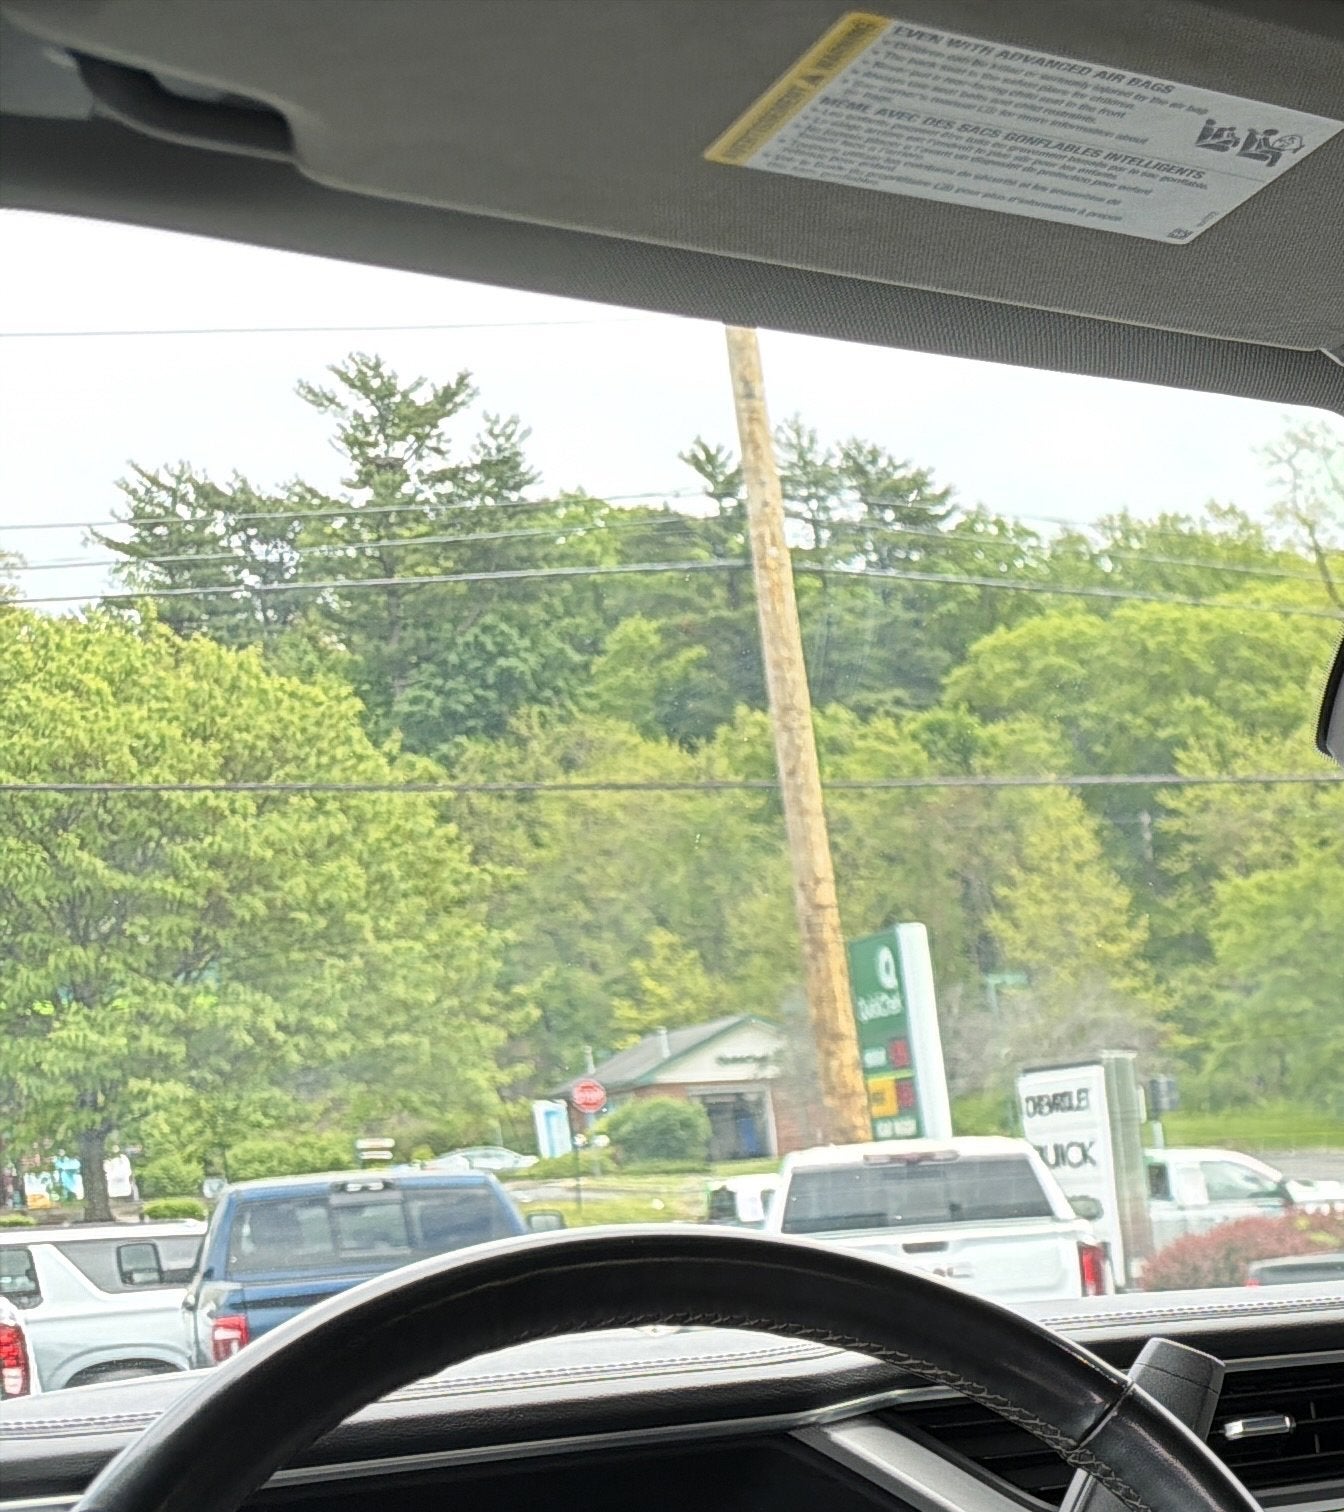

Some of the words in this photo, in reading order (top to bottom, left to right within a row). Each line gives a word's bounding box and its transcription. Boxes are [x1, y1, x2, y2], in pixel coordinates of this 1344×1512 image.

[890, 25, 947, 44] EVEN
[943, 36, 997, 55] WITH
[994, 48, 1094, 77] ADVANCED
[1090, 69, 1127, 84] AIR
[1124, 76, 1177, 95] BAGS
[873, 105, 923, 123] AVEC
[920, 115, 959, 130] DES
[954, 122, 1005, 139] SACS
[1000, 131, 1105, 159] GONFLABLES
[1100, 151, 1210, 179] INTELLIGENTS
[1033, 1141, 1097, 1169] UICK
